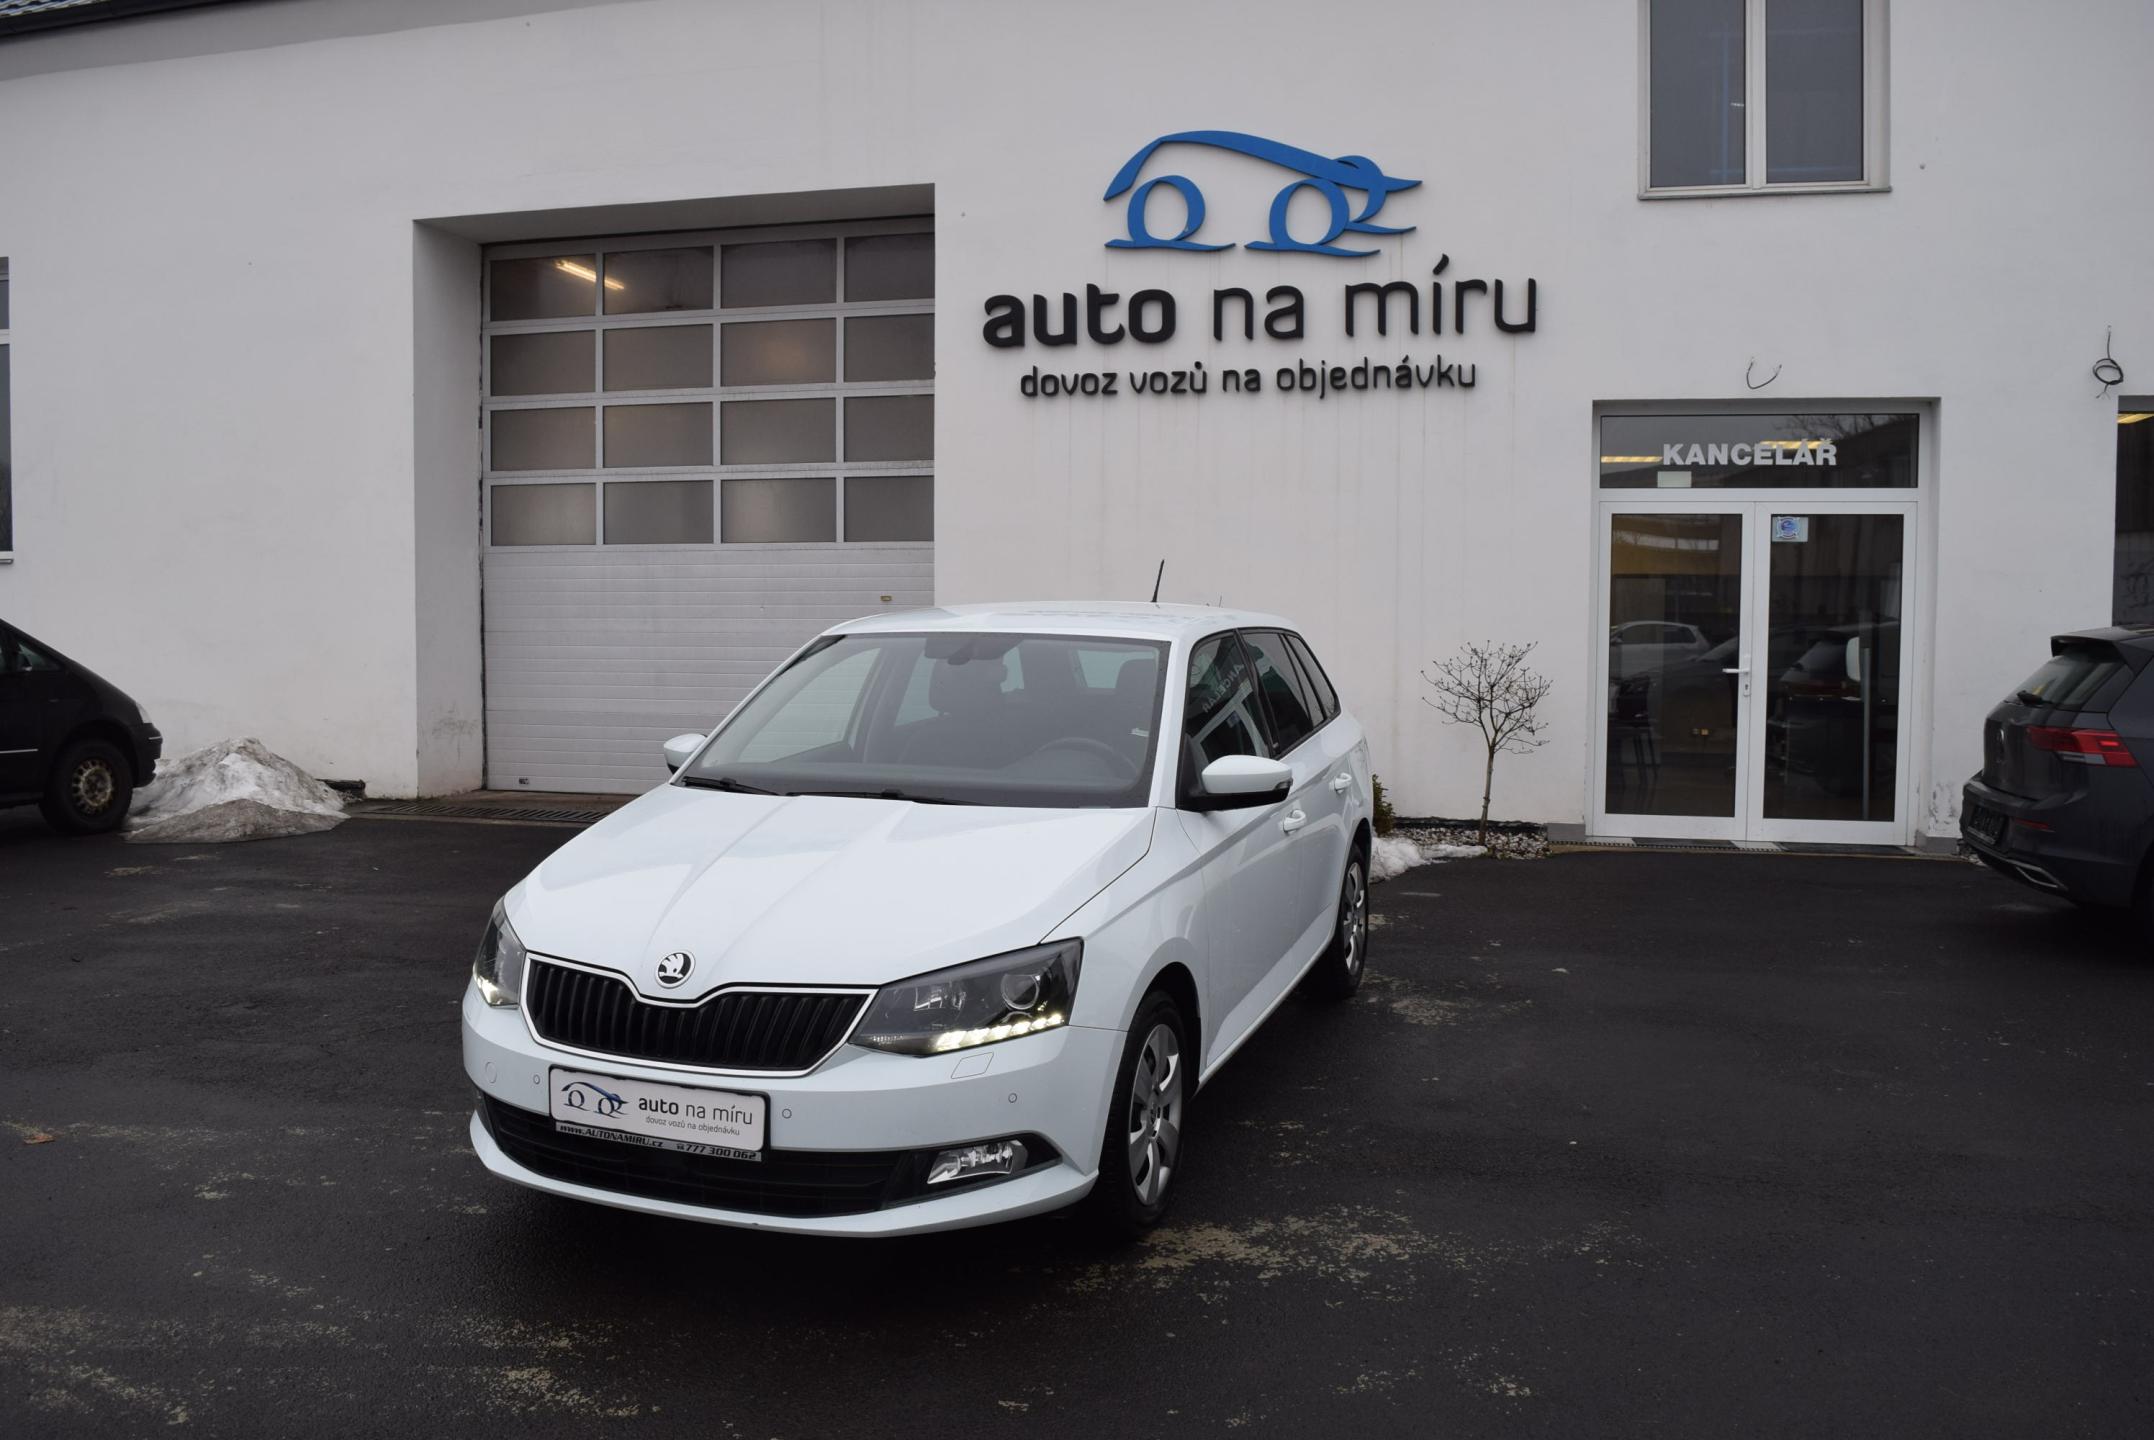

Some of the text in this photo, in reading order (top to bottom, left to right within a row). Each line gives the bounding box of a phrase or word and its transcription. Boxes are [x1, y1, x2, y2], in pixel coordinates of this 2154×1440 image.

[982, 253, 1538, 348] auto na míru
[1020, 354, 1477, 399] dovoz vozů na objednávku
[1662, 437, 1838, 467] KANCELÁŘ
[638, 1097, 753, 1125] auto na míru
[645, 1115, 667, 1126] dovoz
[687, 1122, 697, 1130] na
[698, 1122, 741, 1136] objednávku
[708, 1147, 731, 1157] 300
